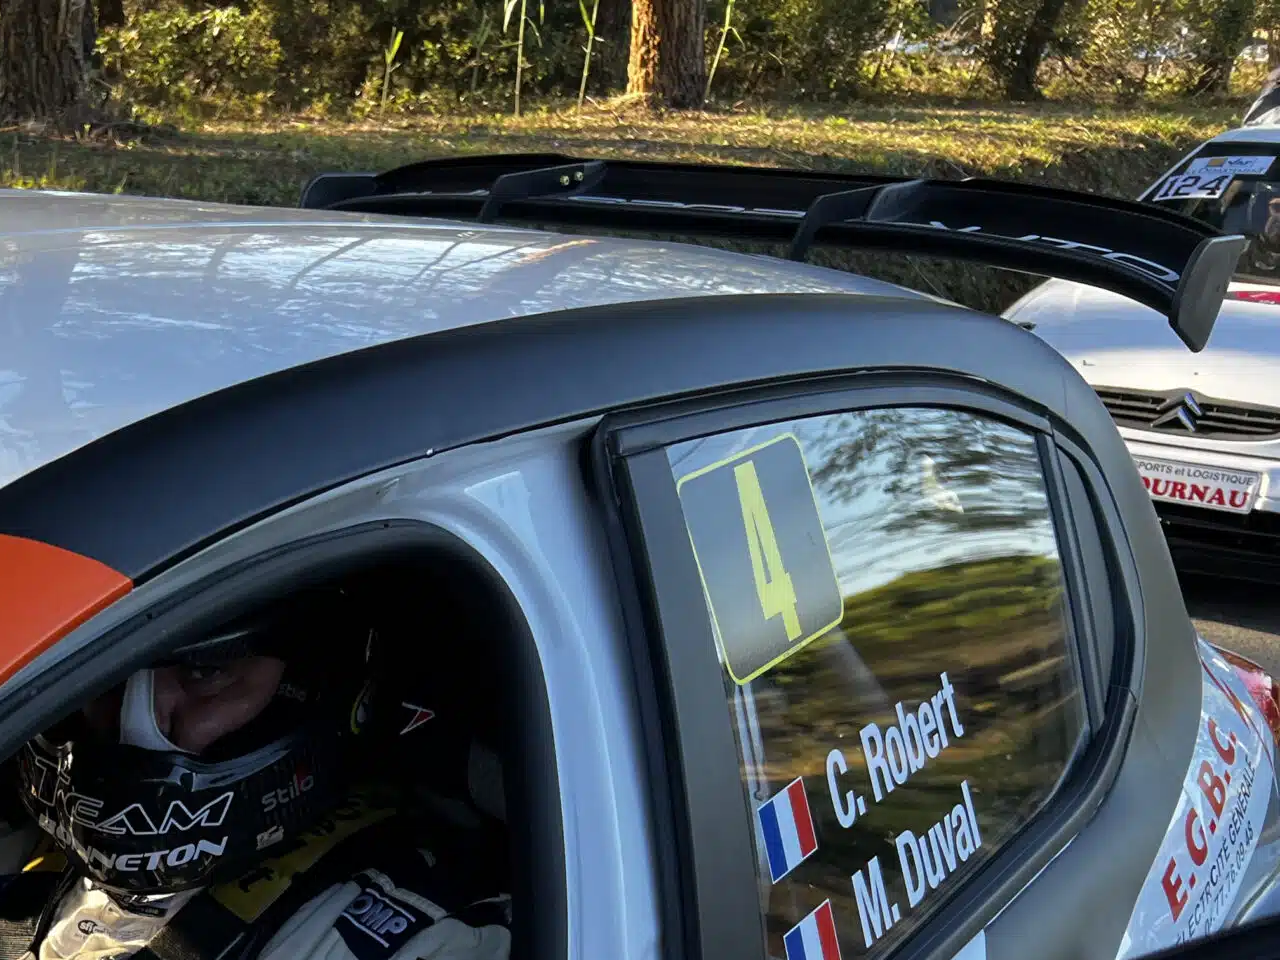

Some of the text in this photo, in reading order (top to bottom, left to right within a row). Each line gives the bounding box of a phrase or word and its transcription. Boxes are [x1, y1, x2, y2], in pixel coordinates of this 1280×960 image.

[1158, 174, 1231, 198] 124
[1136, 460, 1254, 486] PORTS et LOGISTIQUE
[733, 459, 803, 642] 4
[825, 671, 965, 829] C. Robert
[34, 754, 234, 836] TEAM
[260, 773, 315, 812] Stilo
[851, 779, 982, 948] M. Duval
[347, 894, 409, 936] OMP
